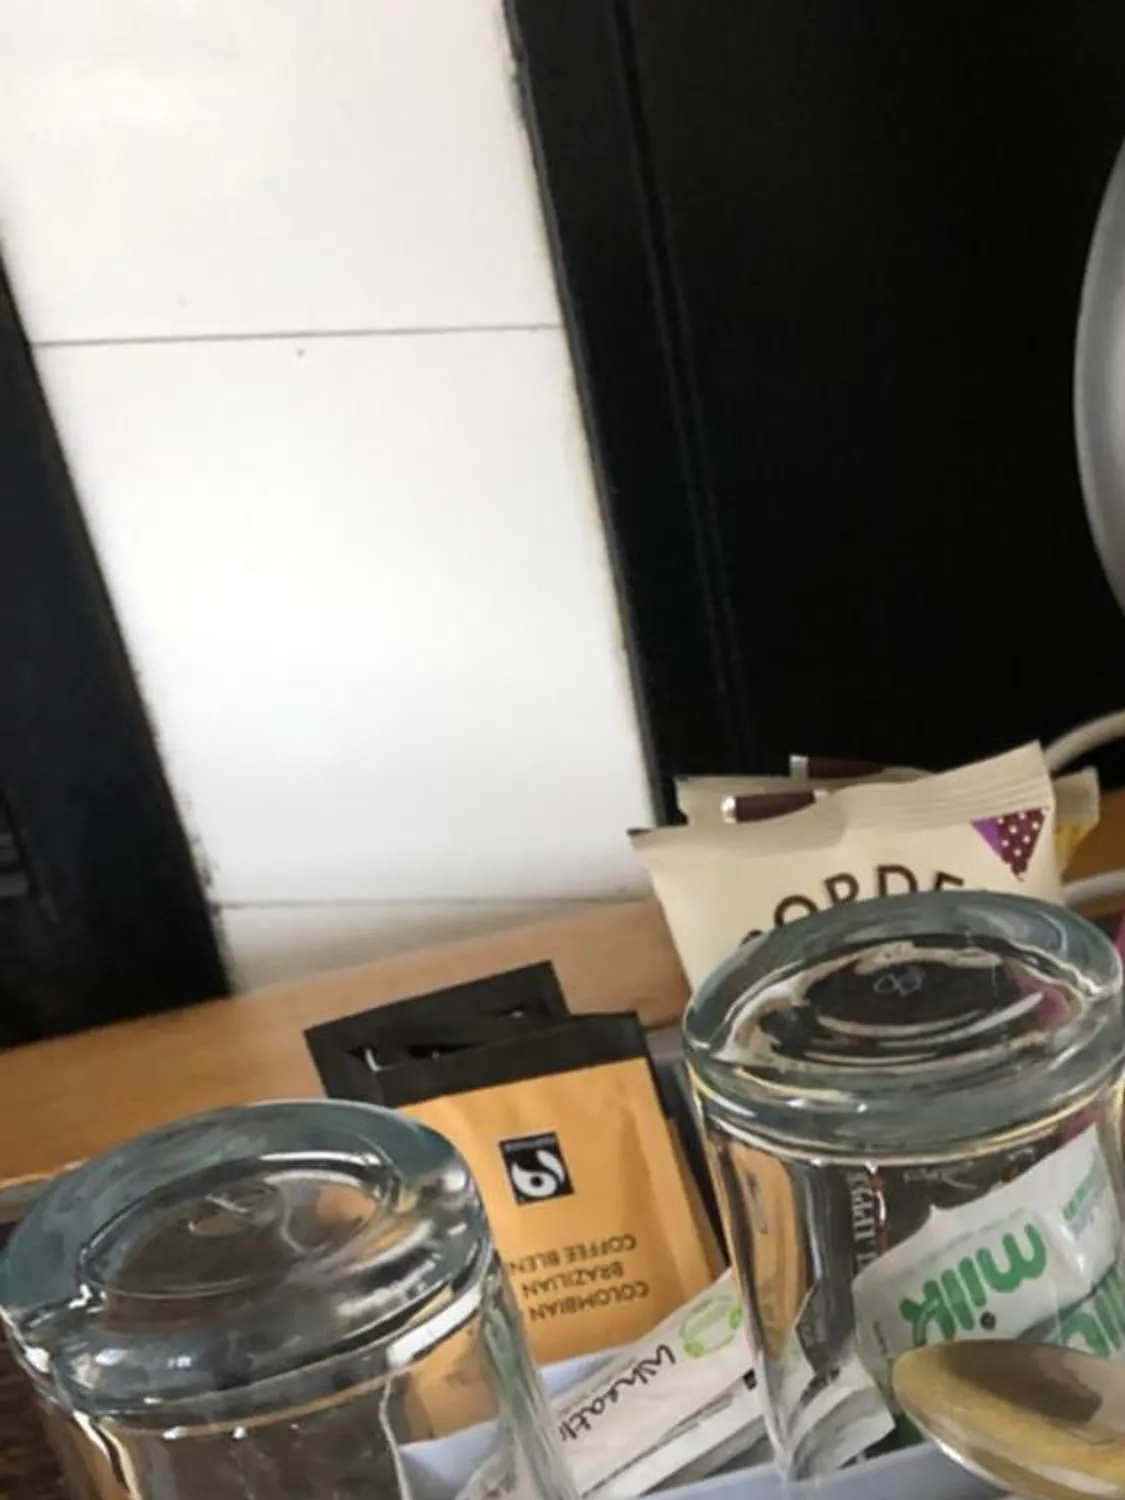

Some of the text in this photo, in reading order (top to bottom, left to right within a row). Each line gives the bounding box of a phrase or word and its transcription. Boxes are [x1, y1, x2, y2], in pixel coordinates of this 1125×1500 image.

[509, 1232, 638, 1277] COFFEE BLEN
[521, 1260, 625, 1299] BRAZILIAN
[529, 1279, 650, 1324] COLOMBIAN
[899, 1222, 1047, 1347] milk
